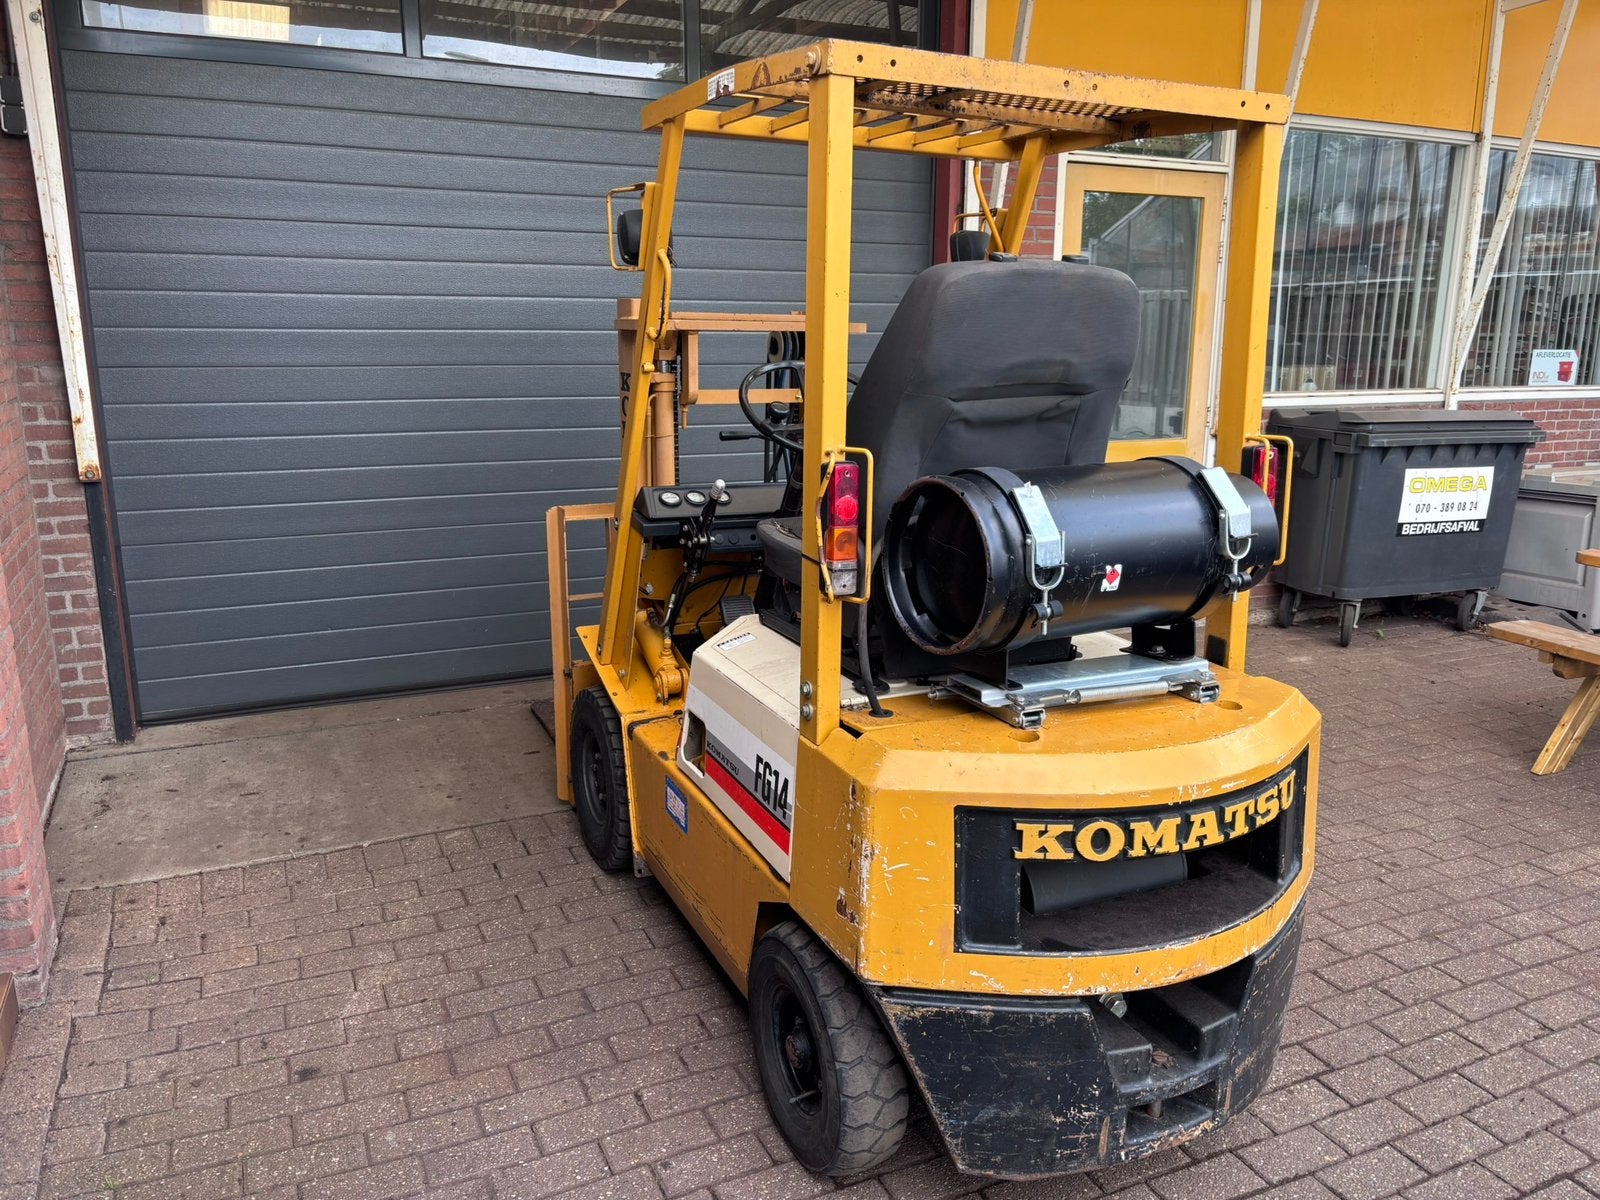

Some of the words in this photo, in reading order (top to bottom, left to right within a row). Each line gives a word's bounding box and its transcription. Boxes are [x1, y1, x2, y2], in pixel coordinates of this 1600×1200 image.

[1409, 476, 1487, 493] OMEGA
[1415, 503, 1431, 513] 070
[1440, 502, 1454, 512] 389
[1457, 502, 1467, 511] 08
[1469, 501, 1478, 511] 24
[1401, 521, 1480, 535] BEDRIJFSAFVAL
[706, 740, 739, 776] KOMATSU
[754, 753, 789, 820] FG14
[1013, 768, 1297, 862] KOMATSU
